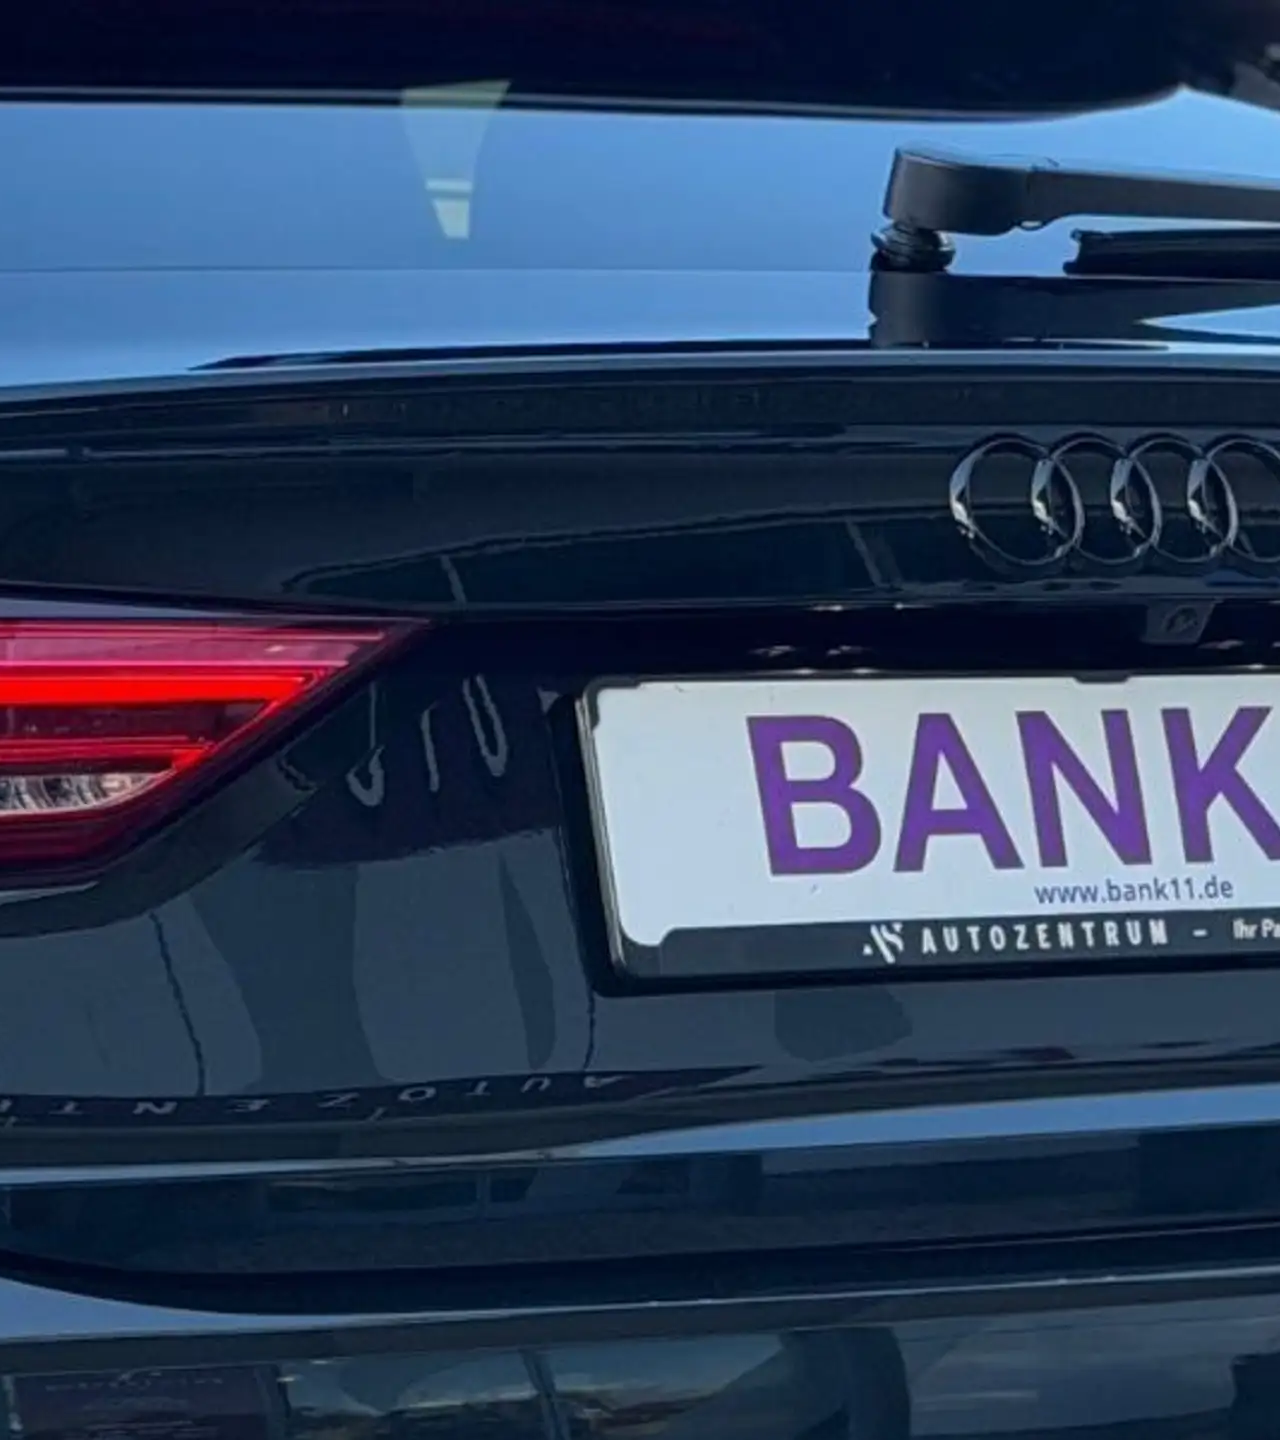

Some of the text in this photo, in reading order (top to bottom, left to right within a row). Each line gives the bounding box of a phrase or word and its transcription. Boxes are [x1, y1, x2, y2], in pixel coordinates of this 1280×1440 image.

[1034, 875, 1234, 905] www.bank11.de
[922, 918, 1168, 954] AUTOZENTRUM
[1232, 918, 1257, 939] Ihr
